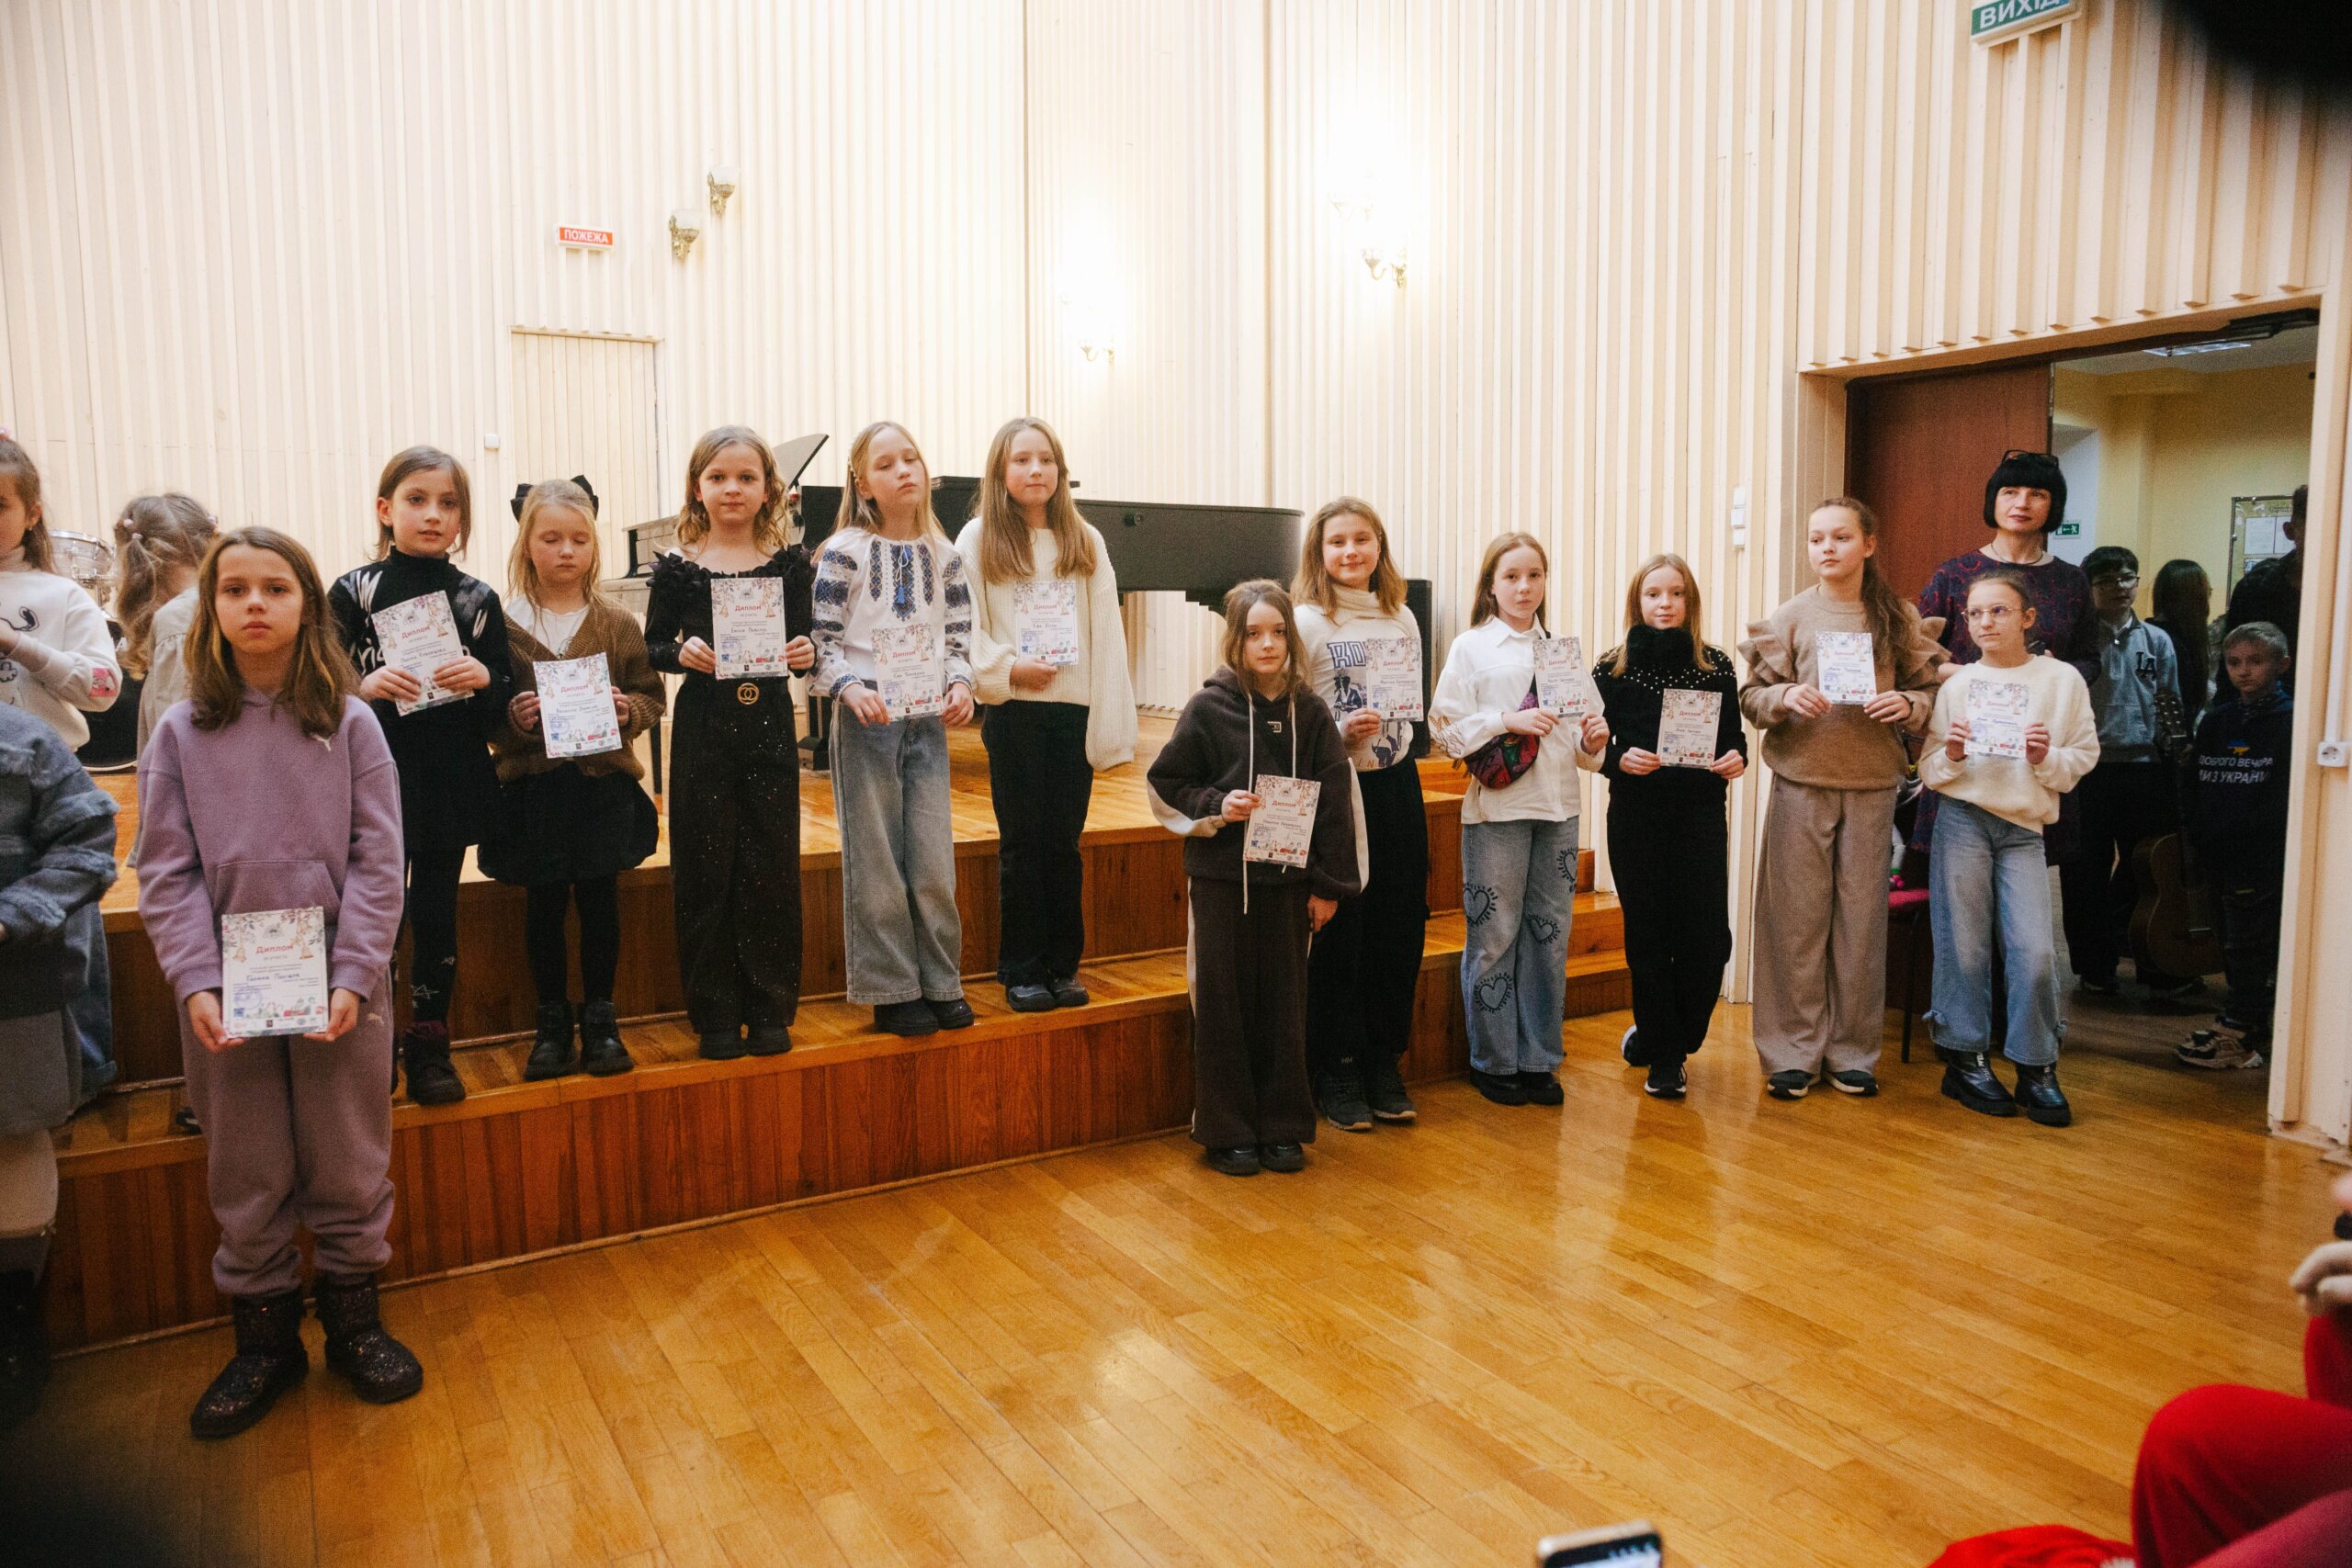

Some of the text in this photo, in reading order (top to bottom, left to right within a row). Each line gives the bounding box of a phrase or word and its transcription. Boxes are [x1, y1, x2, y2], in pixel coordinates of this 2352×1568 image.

[564, 229, 608, 243] ПОЖЕЖА
[401, 626, 430, 639] Диплом
[560, 683, 589, 693] Диплом
[255, 944, 294, 954] Диплом
